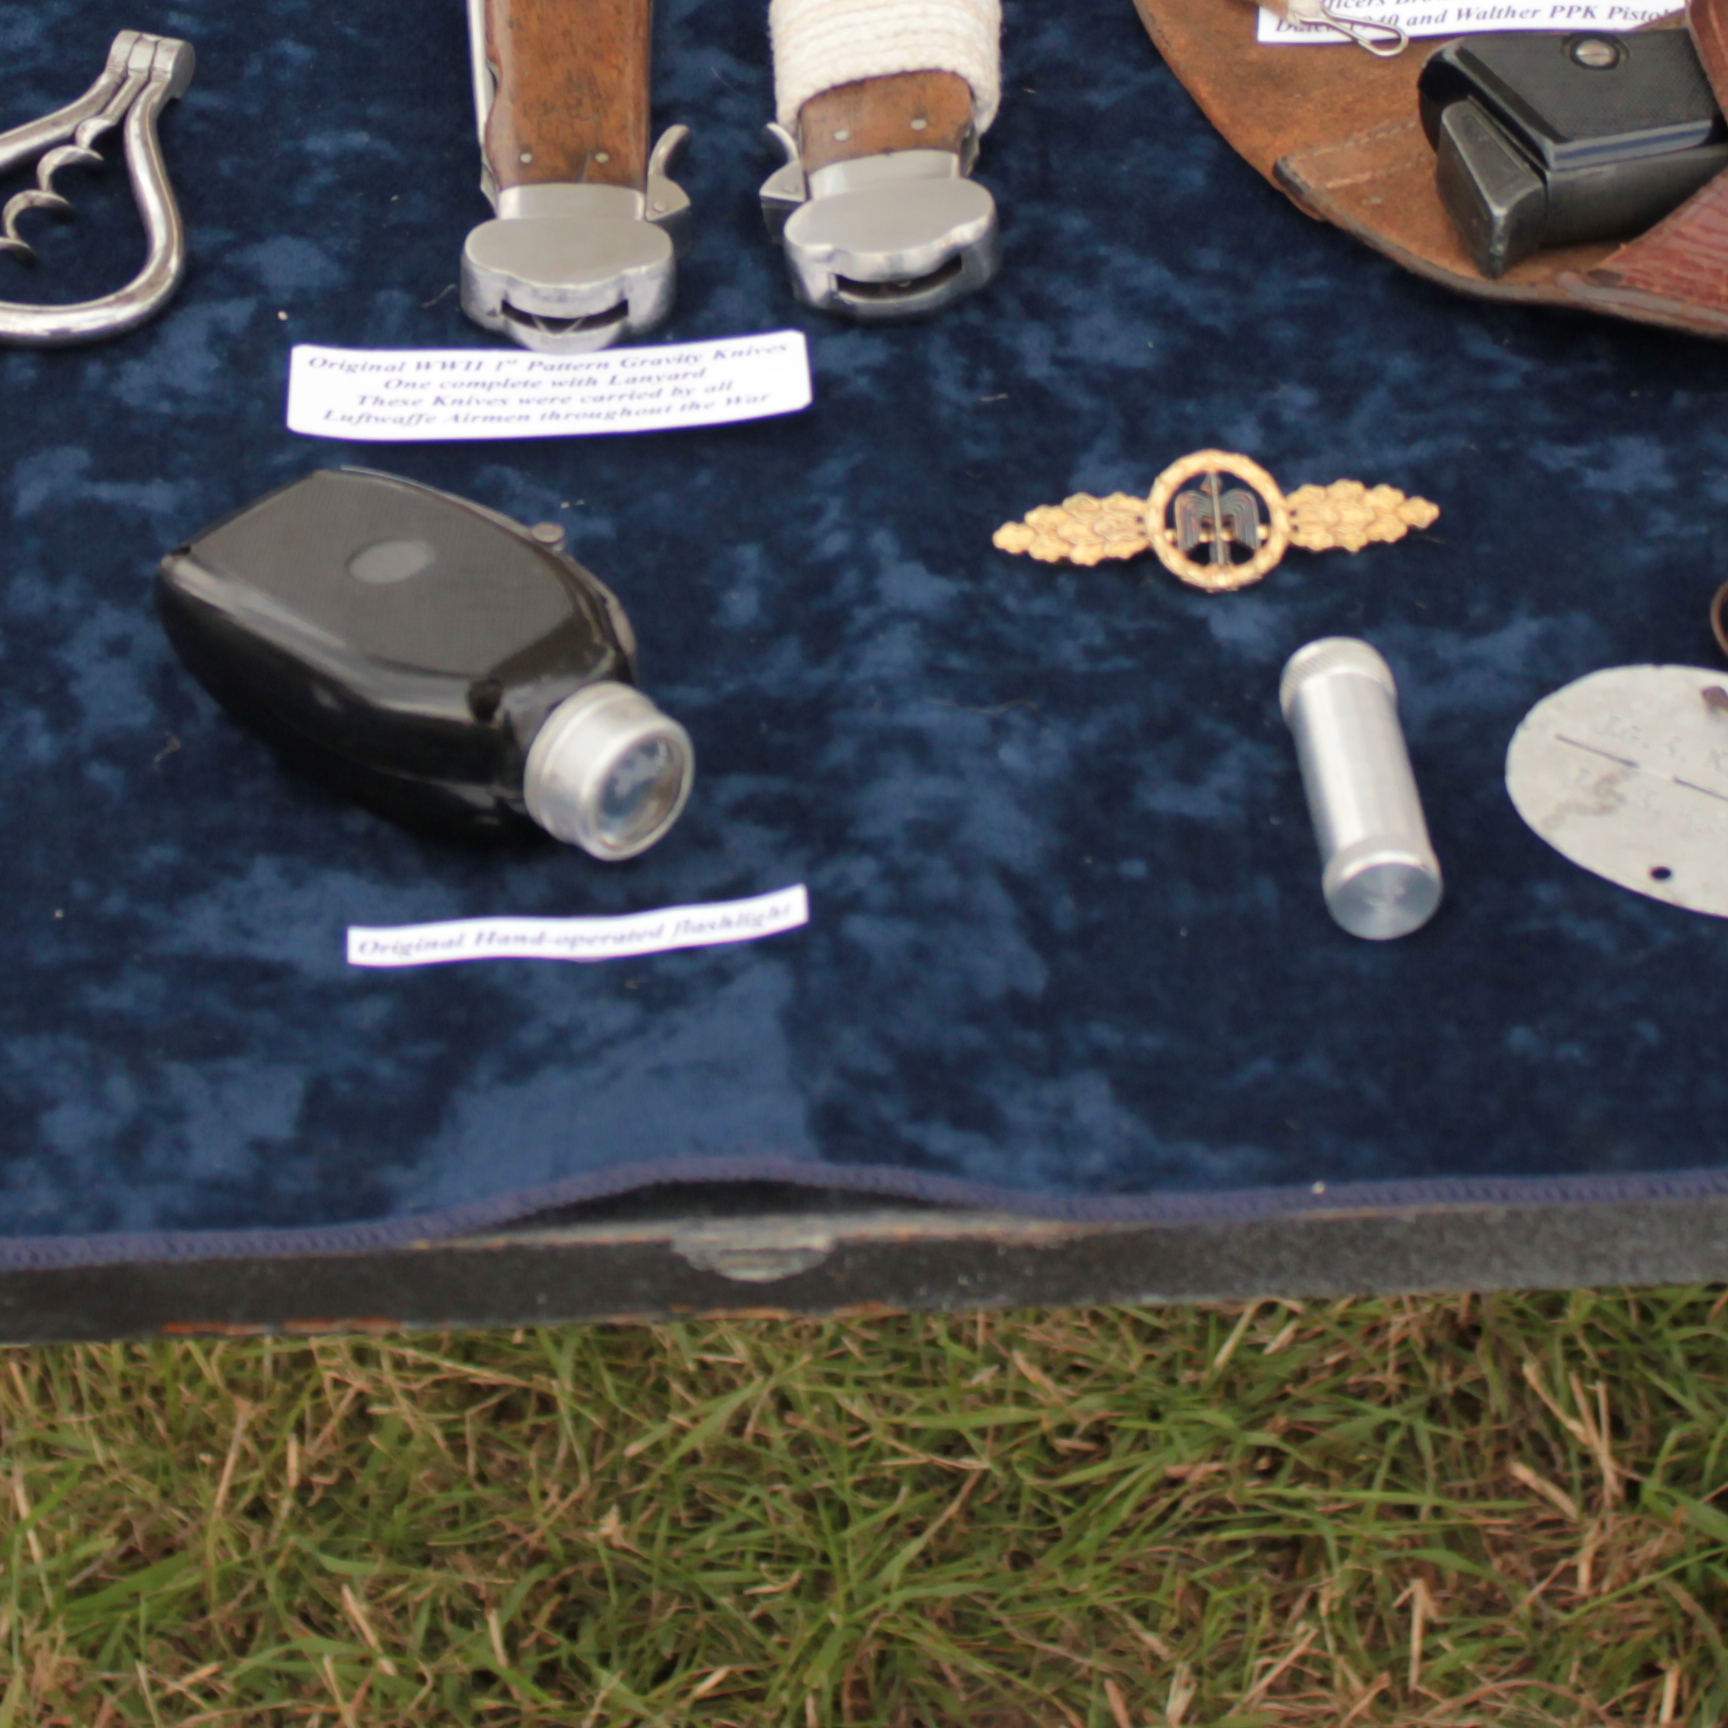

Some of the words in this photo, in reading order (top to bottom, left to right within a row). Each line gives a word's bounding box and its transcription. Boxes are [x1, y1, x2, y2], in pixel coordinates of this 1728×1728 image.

[1406, 9, 1448, 27] and
[1456, 4, 1541, 22] Walther
[1549, 5, 1598, 20] PPK
[308, 357, 406, 374] Original
[415, 360, 484, 372] WWII
[526, 359, 611, 372] Pattern
[619, 351, 703, 368] Gravity
[712, 344, 788, 361] Knives
[384, 378, 432, 390] One
